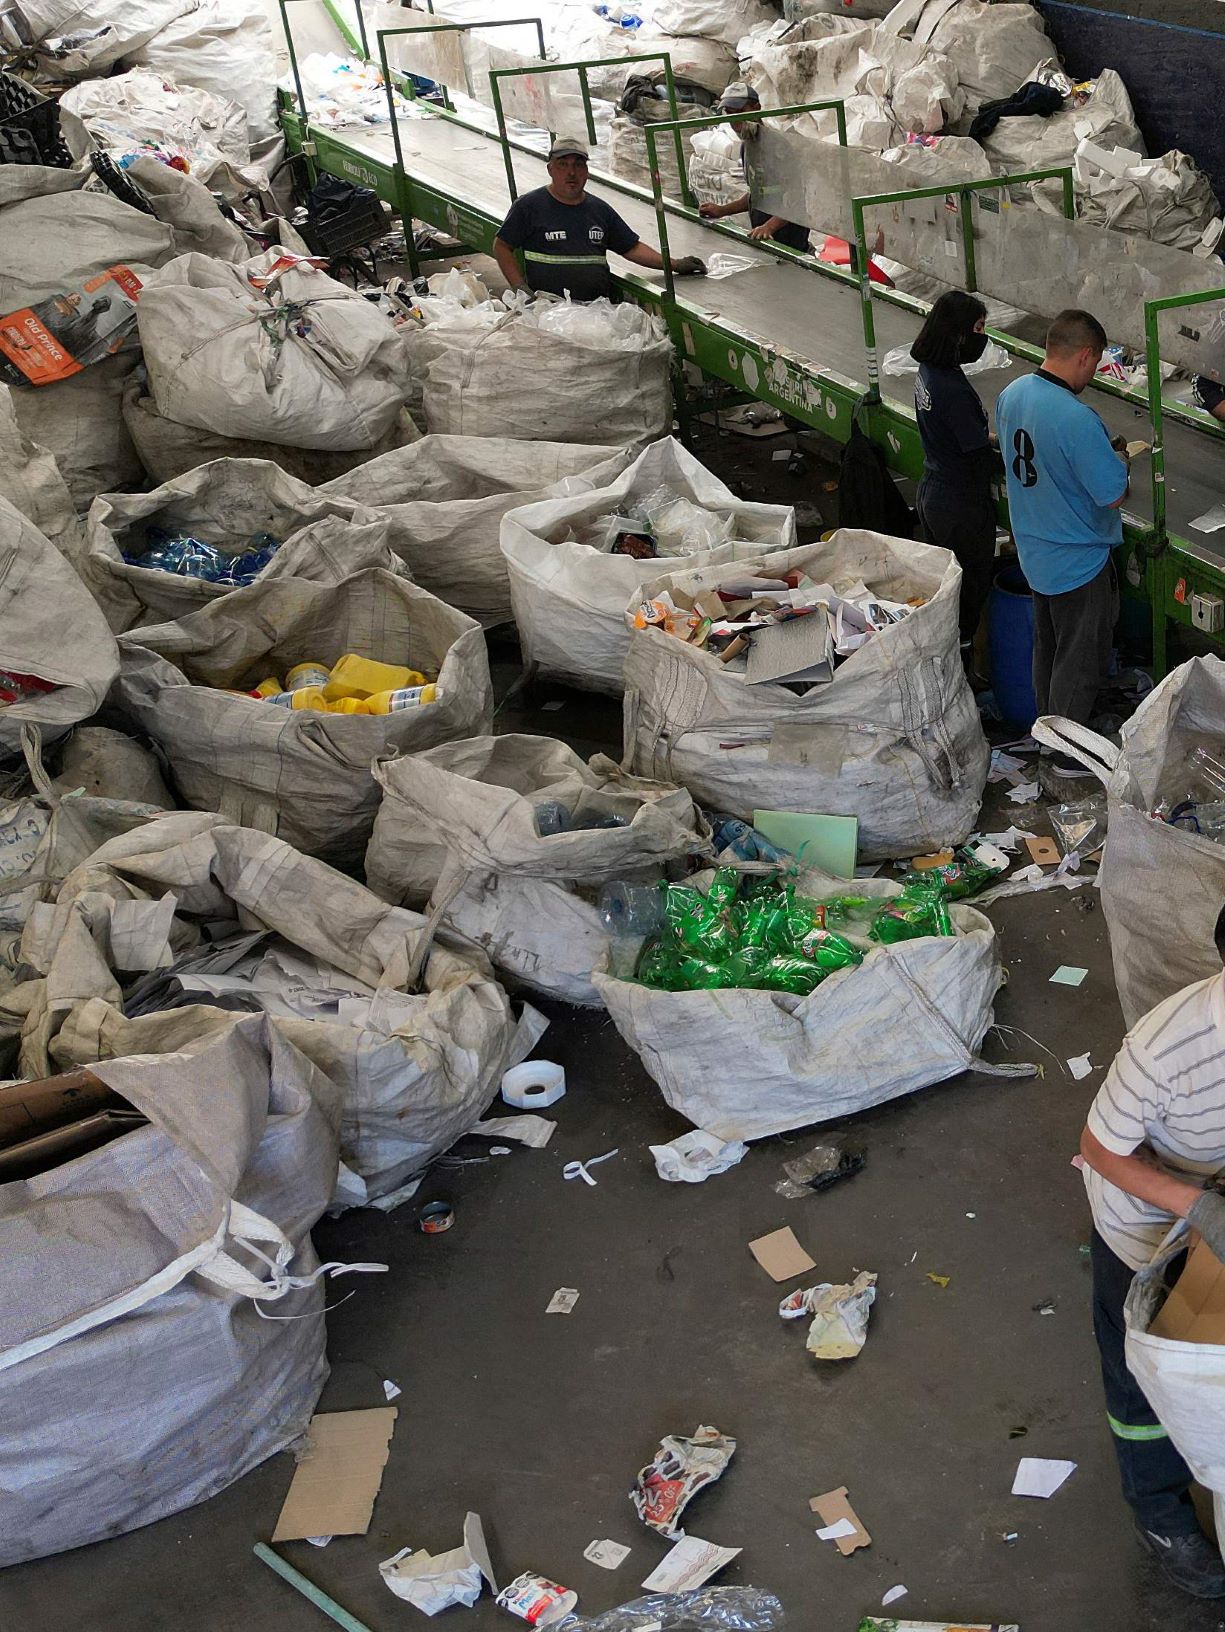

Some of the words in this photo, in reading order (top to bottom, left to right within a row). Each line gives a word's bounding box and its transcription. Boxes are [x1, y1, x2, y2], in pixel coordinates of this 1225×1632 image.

[545, 231, 567, 241] MTE
[24, 317, 42, 335] Old
[37, 333, 64, 361] Prince
[768, 381, 814, 415] ARGENTINA
[1012, 428, 1038, 488] 8
